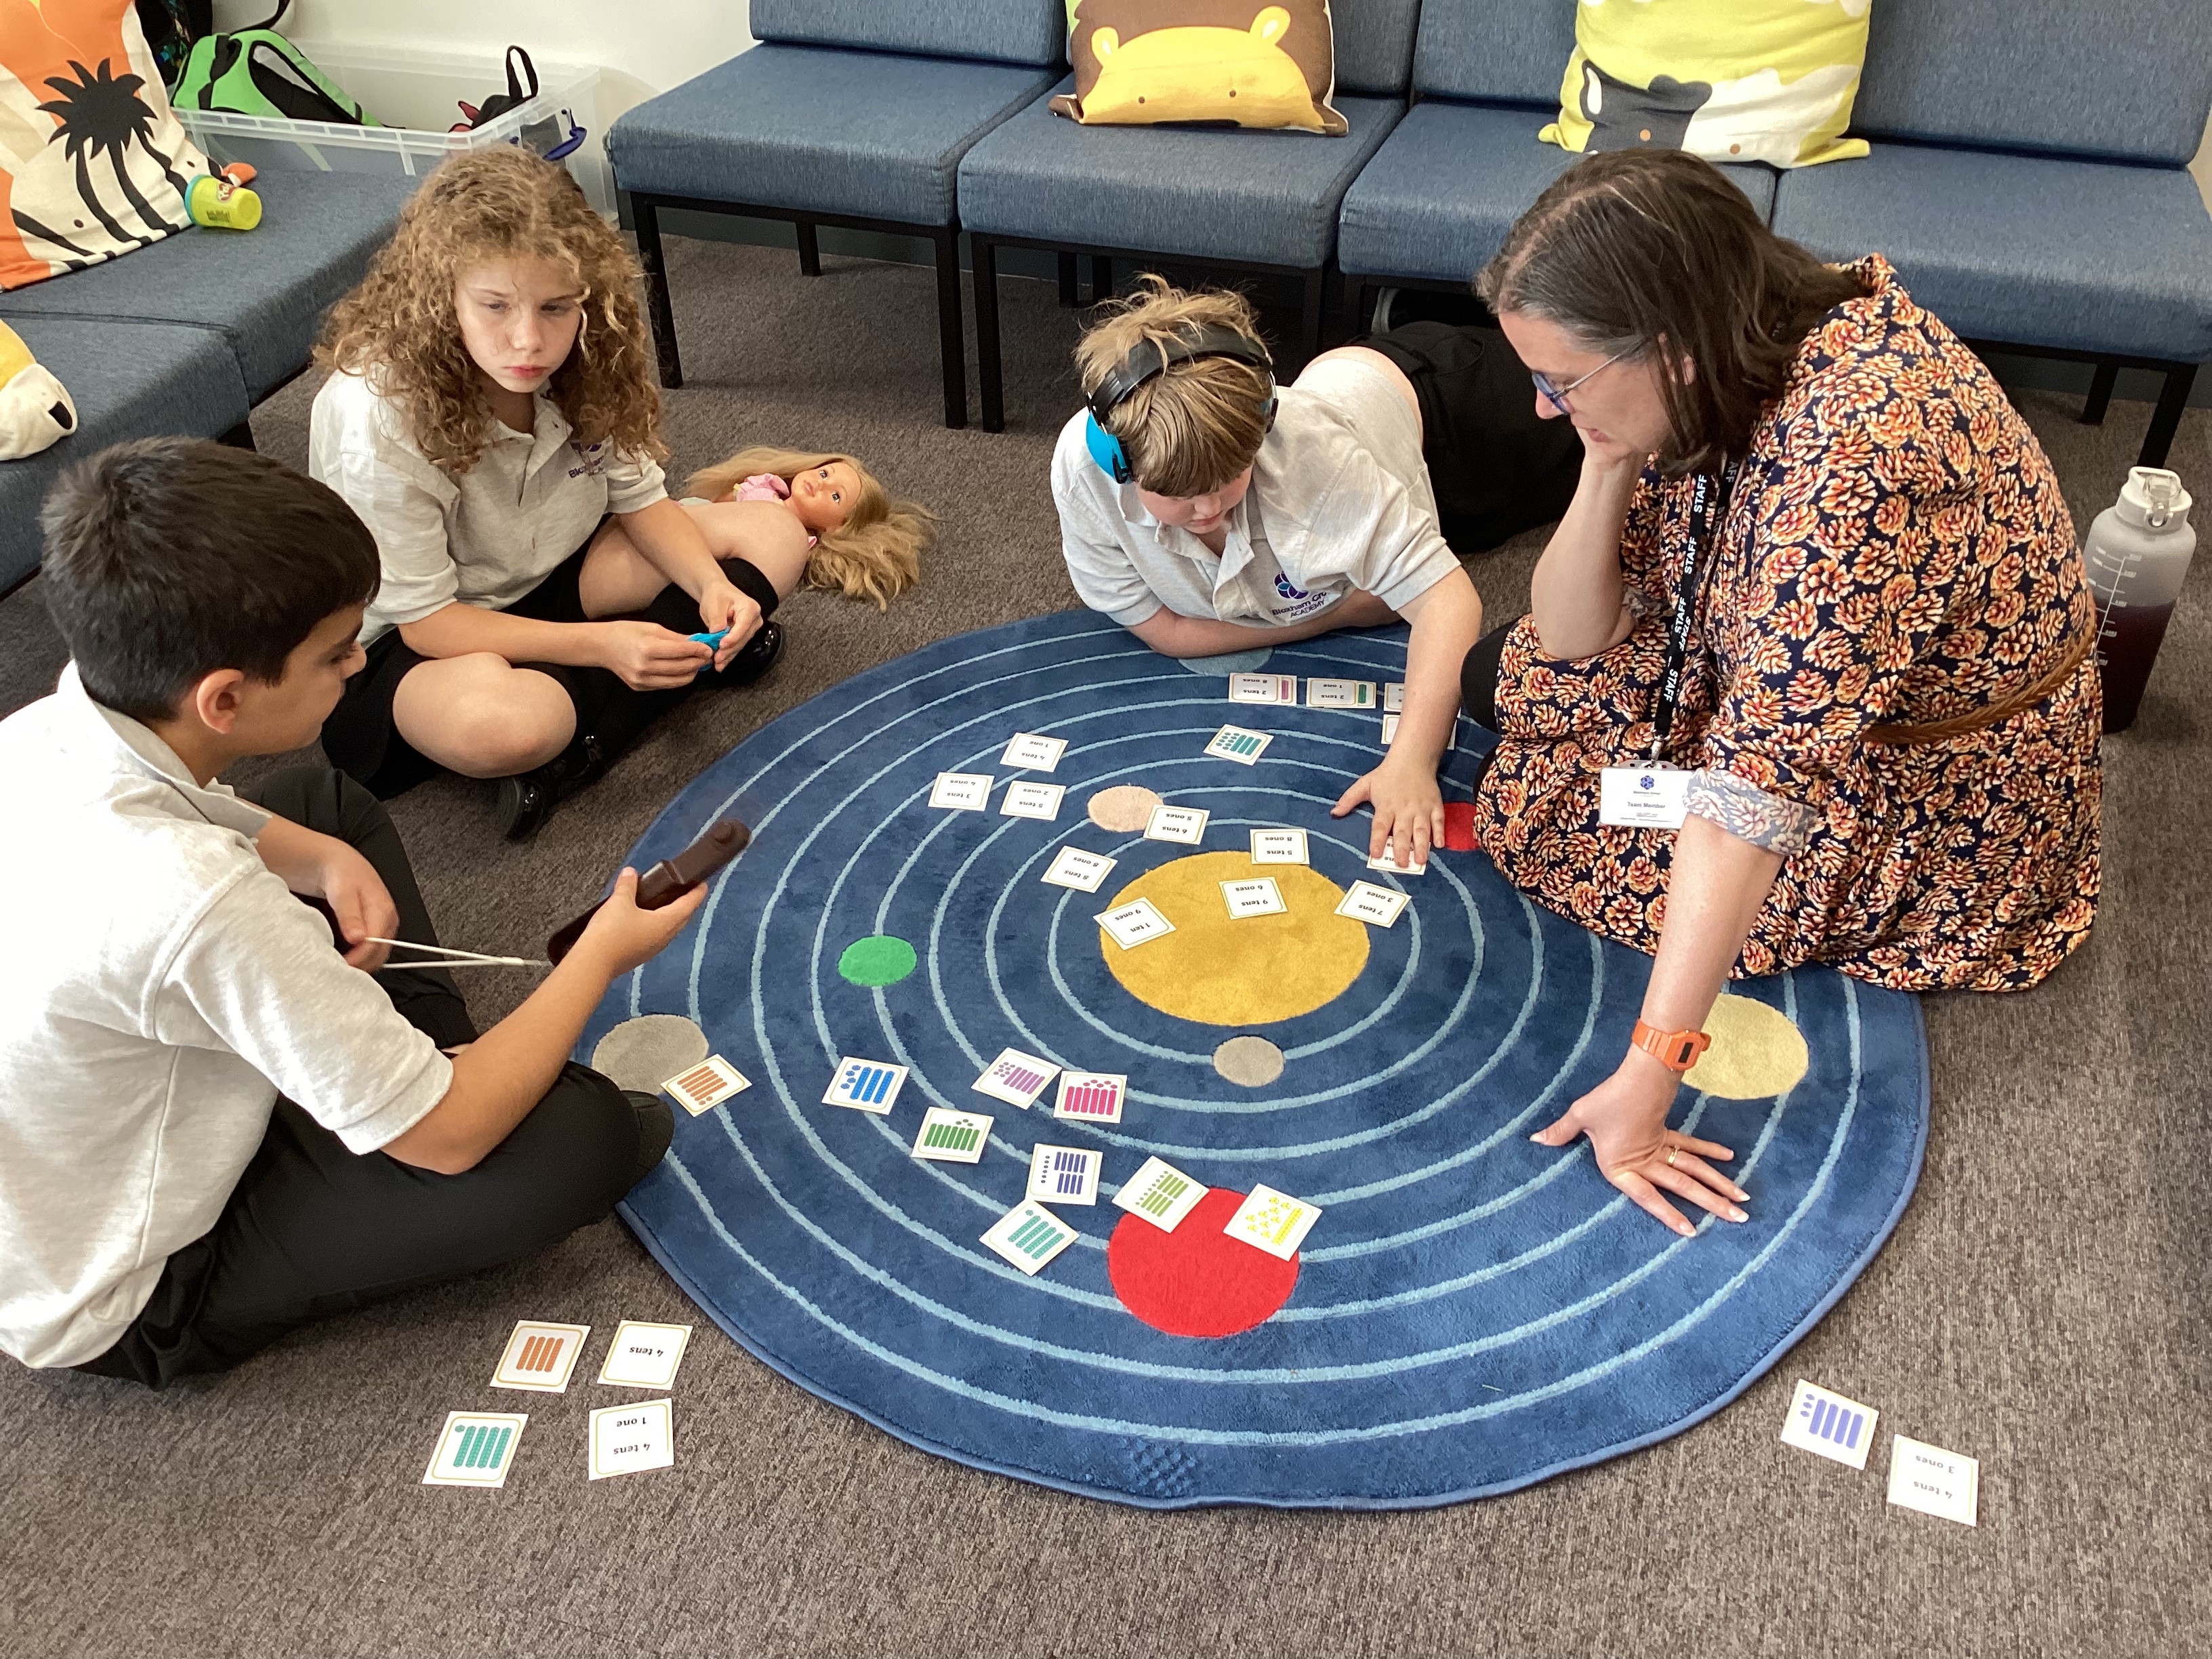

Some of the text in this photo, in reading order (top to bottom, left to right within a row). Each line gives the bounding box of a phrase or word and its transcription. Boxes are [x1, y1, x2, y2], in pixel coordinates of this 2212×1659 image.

[1725, 461, 1739, 483] AFF
[1694, 474, 1707, 513] STAFF
[1684, 536, 1697, 575] STAFF
[1290, 599, 1326, 618] ACADEMY
[1674, 596, 1687, 634] STAFF
[1678, 616, 1692, 652] STAFF
[1663, 668, 1679, 703] STAFF
[1073, 857, 1092, 865] ones
[1064, 870, 1082, 878] tens
[1366, 891, 1386, 899] ones
[1358, 904, 1376, 913] tens
[1114, 912, 1134, 921] ones
[1130, 924, 1145, 933] ten
[629, 1347, 663, 1357] 4 tens
[617, 1416, 647, 1427] 1 one
[613, 1443, 651, 1455] 4 tens
[1915, 1455, 1955, 1474] 3 ones
[1913, 1481, 1952, 1499] 4 tens
